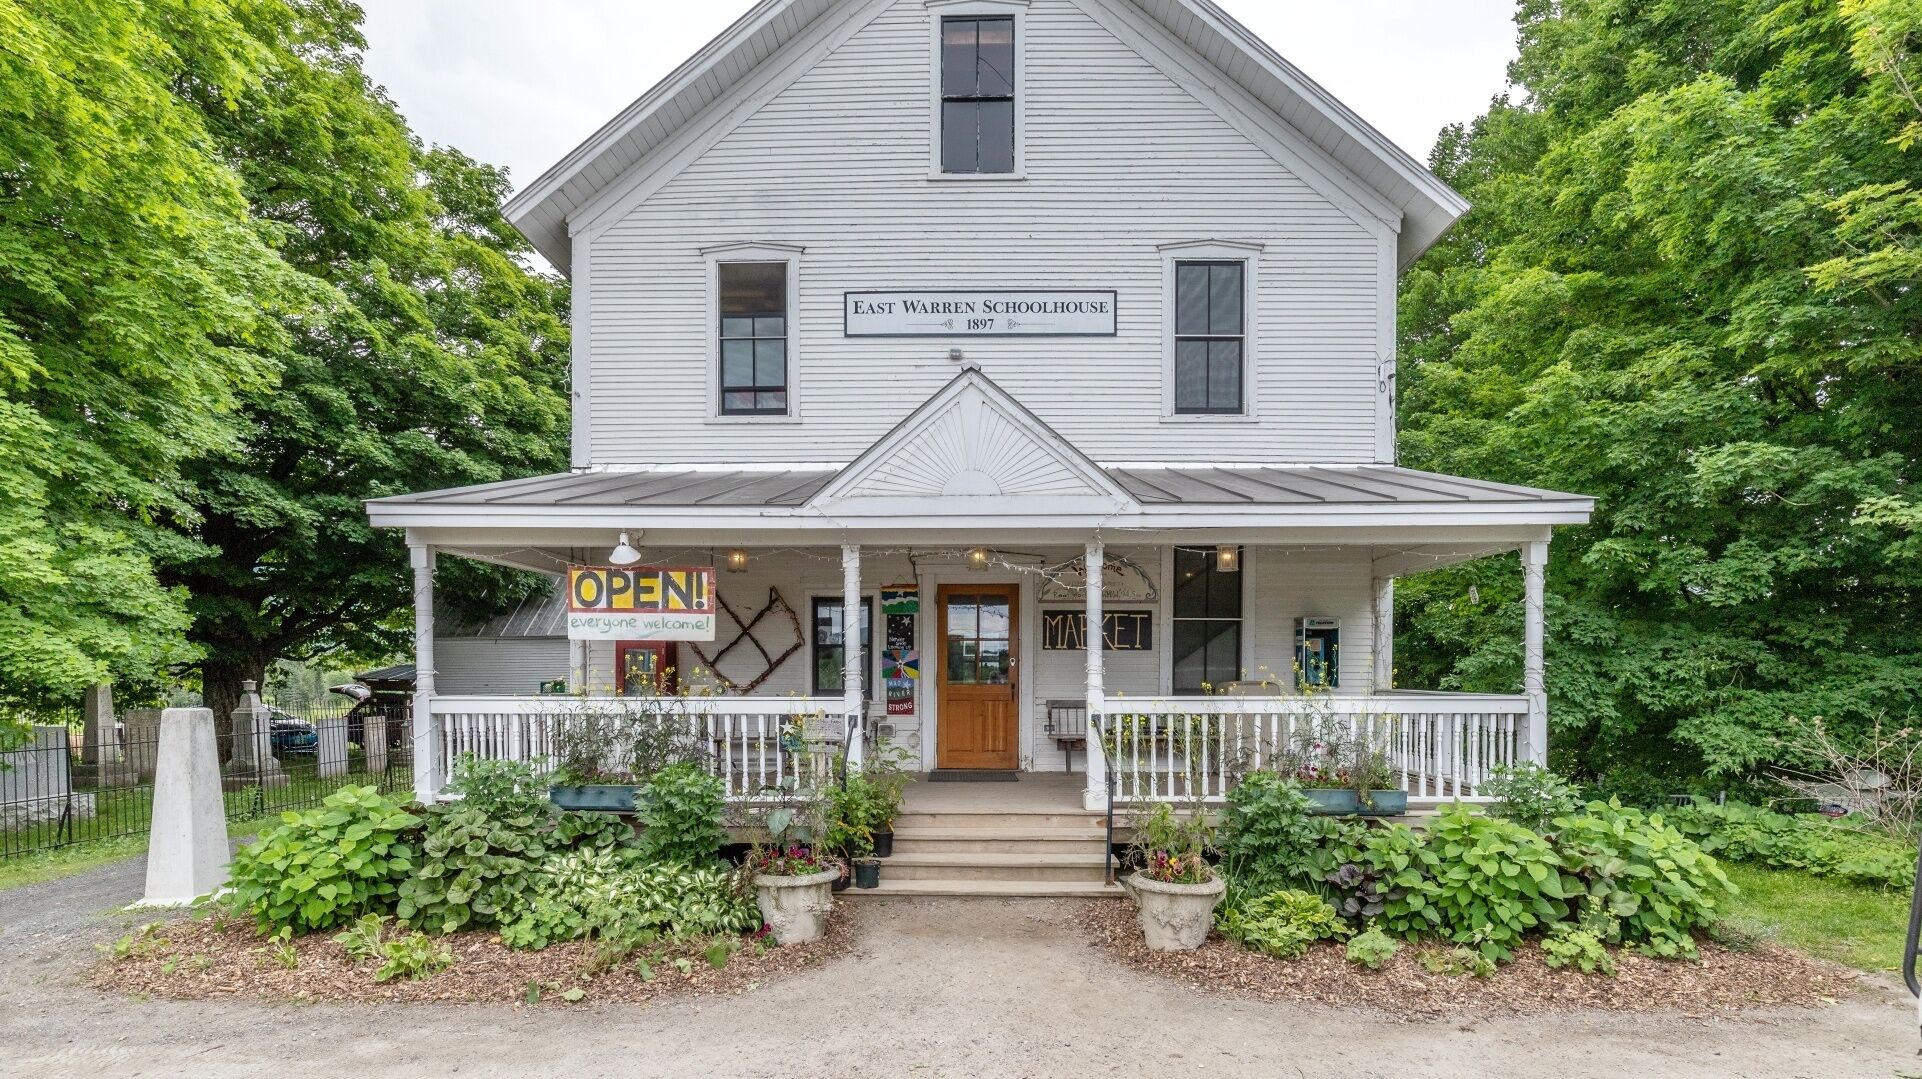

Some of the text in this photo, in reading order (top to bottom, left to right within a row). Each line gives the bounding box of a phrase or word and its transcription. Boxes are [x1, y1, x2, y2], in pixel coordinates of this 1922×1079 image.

[966, 318, 994, 330] 1897
[574, 571, 705, 609] OPEN!
[570, 615, 710, 634] everyone welcome!
[888, 689, 911, 698] RIVER
[888, 701, 913, 711] STRONG
